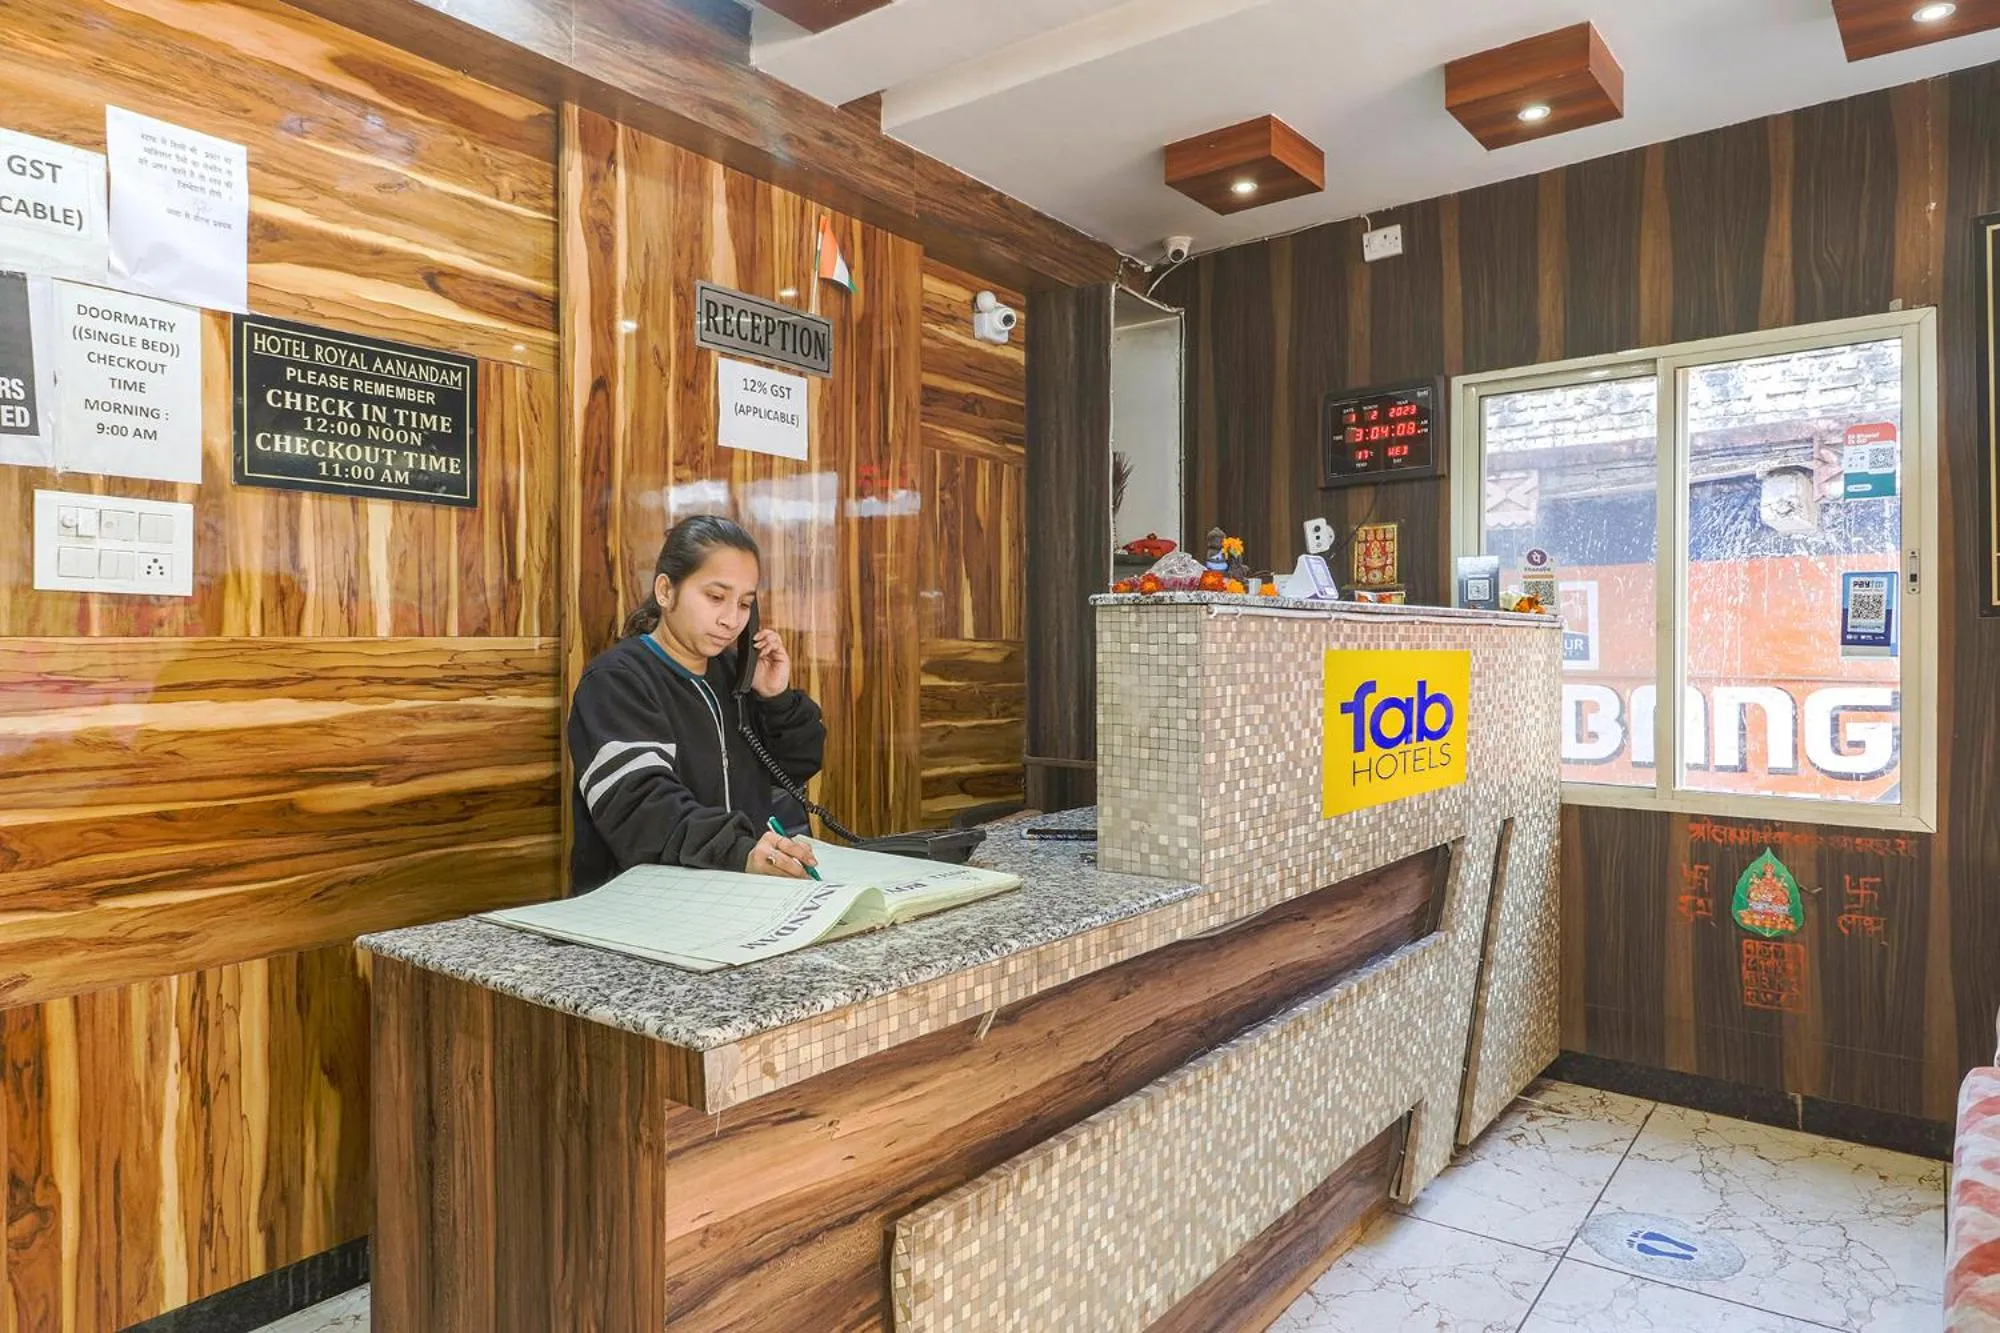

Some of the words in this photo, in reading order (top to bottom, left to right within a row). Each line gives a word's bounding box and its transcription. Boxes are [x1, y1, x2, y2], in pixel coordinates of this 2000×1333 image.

[7, 155, 63, 184] GST
[77, 303, 176, 333] DOORMATRY
[704, 299, 827, 363] RECEPTION
[87, 351, 168, 376] CHECKOUT
[253, 332, 310, 360] HOTEL
[315, 343, 368, 371] ROYAL
[372, 356, 462, 388] AANANDAM
[109, 377, 147, 395] TIME
[286, 367, 349, 391] PLEASE
[353, 379, 436, 406] REMEMBER
[743, 377, 767, 396] 12%
[770, 384, 792, 400] GST
[84, 398, 161, 420] MORNING
[266, 388, 355, 419] CHECK
[361, 403, 386, 424] IN
[394, 407, 453, 434] TIME
[734, 402, 800, 429] (APPLICABLE)
[1388, 405, 1417, 418] 2023
[96, 423, 129, 437] 9:00
[132, 428, 158, 441] AM
[303, 416, 361, 438] 12:00
[367, 425, 423, 447] NOON
[255, 431, 397, 467] CHECKOUT
[404, 450, 462, 476] TIME
[318, 461, 375, 481] 11:00
[380, 469, 410, 486] AM
[1340, 680, 1455, 754] fab
[1353, 742, 1452, 787] HOTELS
